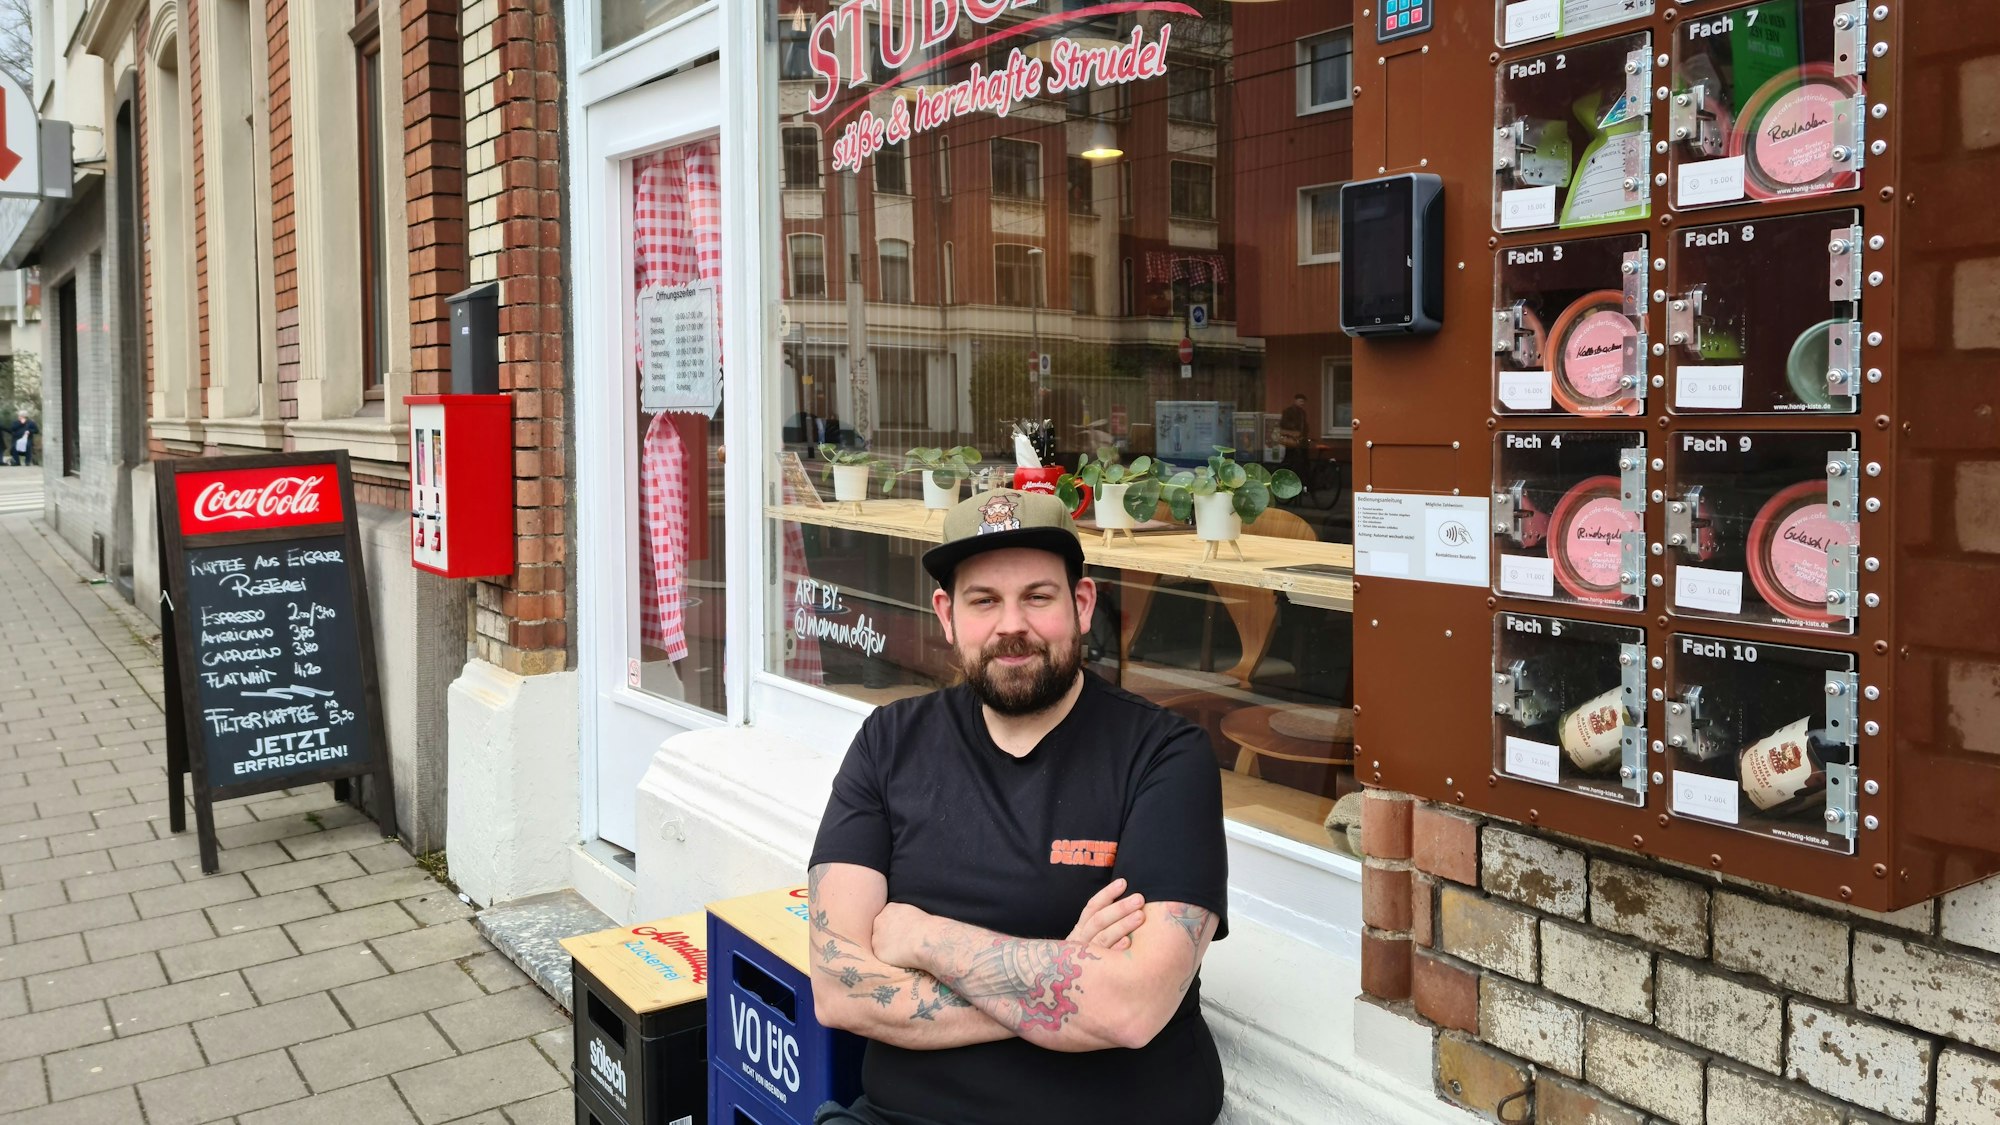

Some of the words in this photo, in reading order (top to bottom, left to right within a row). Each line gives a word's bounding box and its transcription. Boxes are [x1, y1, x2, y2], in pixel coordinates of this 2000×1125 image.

[1689, 16, 1734, 40] Fach
[1746, 9, 1759, 27] 7
[808, 0, 1038, 115] STUB
[1509, 59, 1546, 80] Fach
[1556, 54, 1567, 70] 2
[832, 110, 883, 173] süße
[887, 95, 912, 145] &
[914, 47, 1041, 134] herzhafte
[1047, 23, 1172, 94] Strudel
[1768, 112, 1827, 142] Rouladen
[1776, 182, 1835, 195] www.honig-kiste.de
[1685, 228, 1730, 247] Fach
[1741, 225, 1754, 242] 8
[1508, 247, 1544, 265] Fach
[1553, 246, 1563, 261] 3
[656, 288, 696, 301] Öffnungszeiten
[1774, 403, 1831, 411] www.honig-kiste.de
[1506, 434, 1542, 449] Fach
[1551, 435, 1562, 449] 4
[1683, 436, 1727, 452] Fach
[1739, 436, 1752, 453] 9
[194, 475, 324, 522] Coca-Cola
[1784, 526, 1823, 551] Gulasch
[795, 579, 819, 605] ART
[822, 585, 843, 611] BY:
[289, 624, 314, 642] 3,50
[1506, 615, 1542, 634] Fach
[1551, 621, 1562, 636] 5
[1771, 617, 1829, 628] www.honig-kiste.de
[292, 642, 318, 656] 3,80
[1682, 639, 1727, 658] Fach
[1733, 646, 1757, 663] 10
[294, 662, 321, 678] 4,20
[248, 727, 330, 757] JETZT
[233, 745, 348, 775] ERFRISCHEN!
[1748, 752, 1765, 789] CHOCOLATE
[1753, 749, 1772, 788] KONZENTRAT
[1759, 754, 1771, 778] KAFFEE
[1578, 784, 1624, 800] www.honig-kiste.de
[1772, 828, 1829, 846] www.honig-kiste.de
[625, 940, 686, 981] Zuckerfrei
[730, 993, 761, 1064] VO
[766, 1020, 800, 1093] ÜS
[590, 1037, 627, 1098] sölsch
[742, 1062, 755, 1078] NICHT
[755, 1072, 764, 1087] VON
[764, 1079, 787, 1104] IRGENDWO
